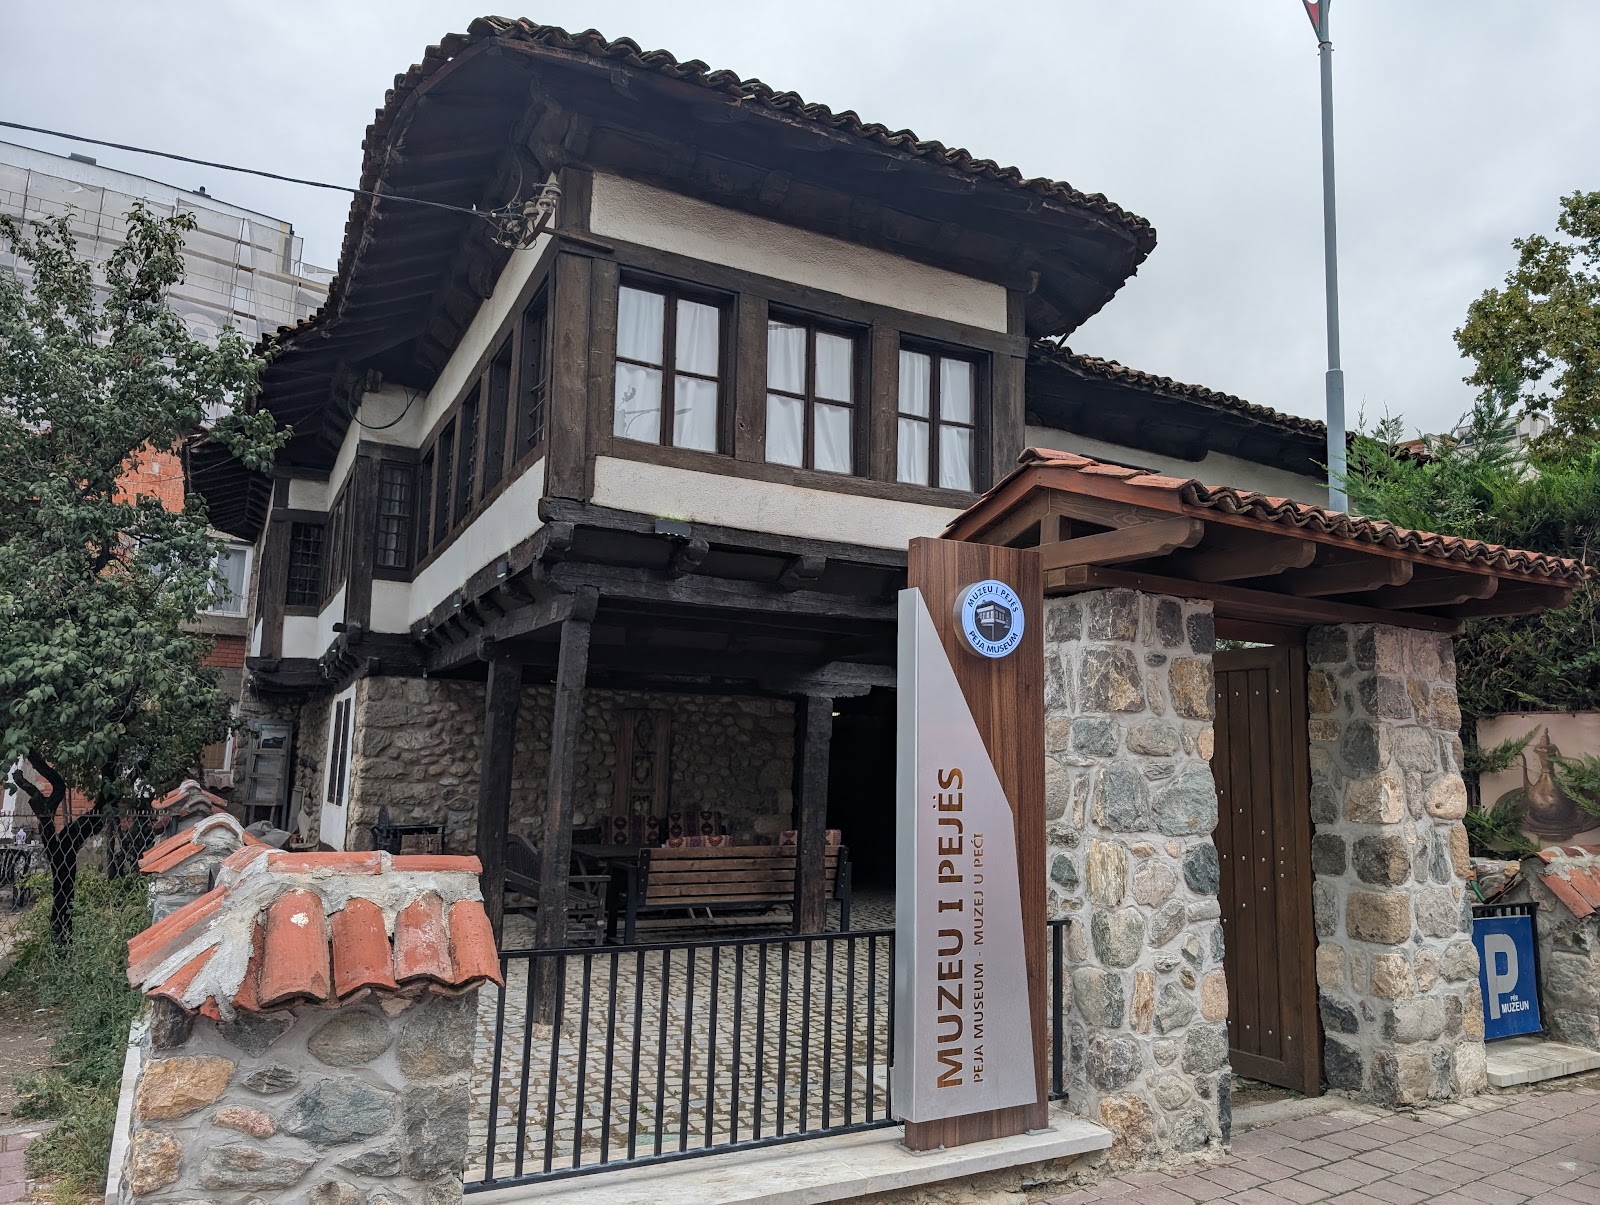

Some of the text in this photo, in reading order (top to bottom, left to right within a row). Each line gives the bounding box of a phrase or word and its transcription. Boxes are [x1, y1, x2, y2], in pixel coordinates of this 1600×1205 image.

[967, 585, 993, 608] MUZEU
[995, 586, 999, 594] I
[969, 630, 1019, 653] PEJA MUSEUM
[970, 832, 984, 868] PEĆI
[973, 873, 984, 885] U
[932, 767, 964, 1089] MUZEU I PEJËS
[973, 890, 984, 946] MUZEJ
[1484, 933, 1519, 1020] P
[973, 963, 984, 1039] MUSEUM
[1501, 1000, 1530, 1014] MUZEUN
[973, 1044, 984, 1083] PEJA
